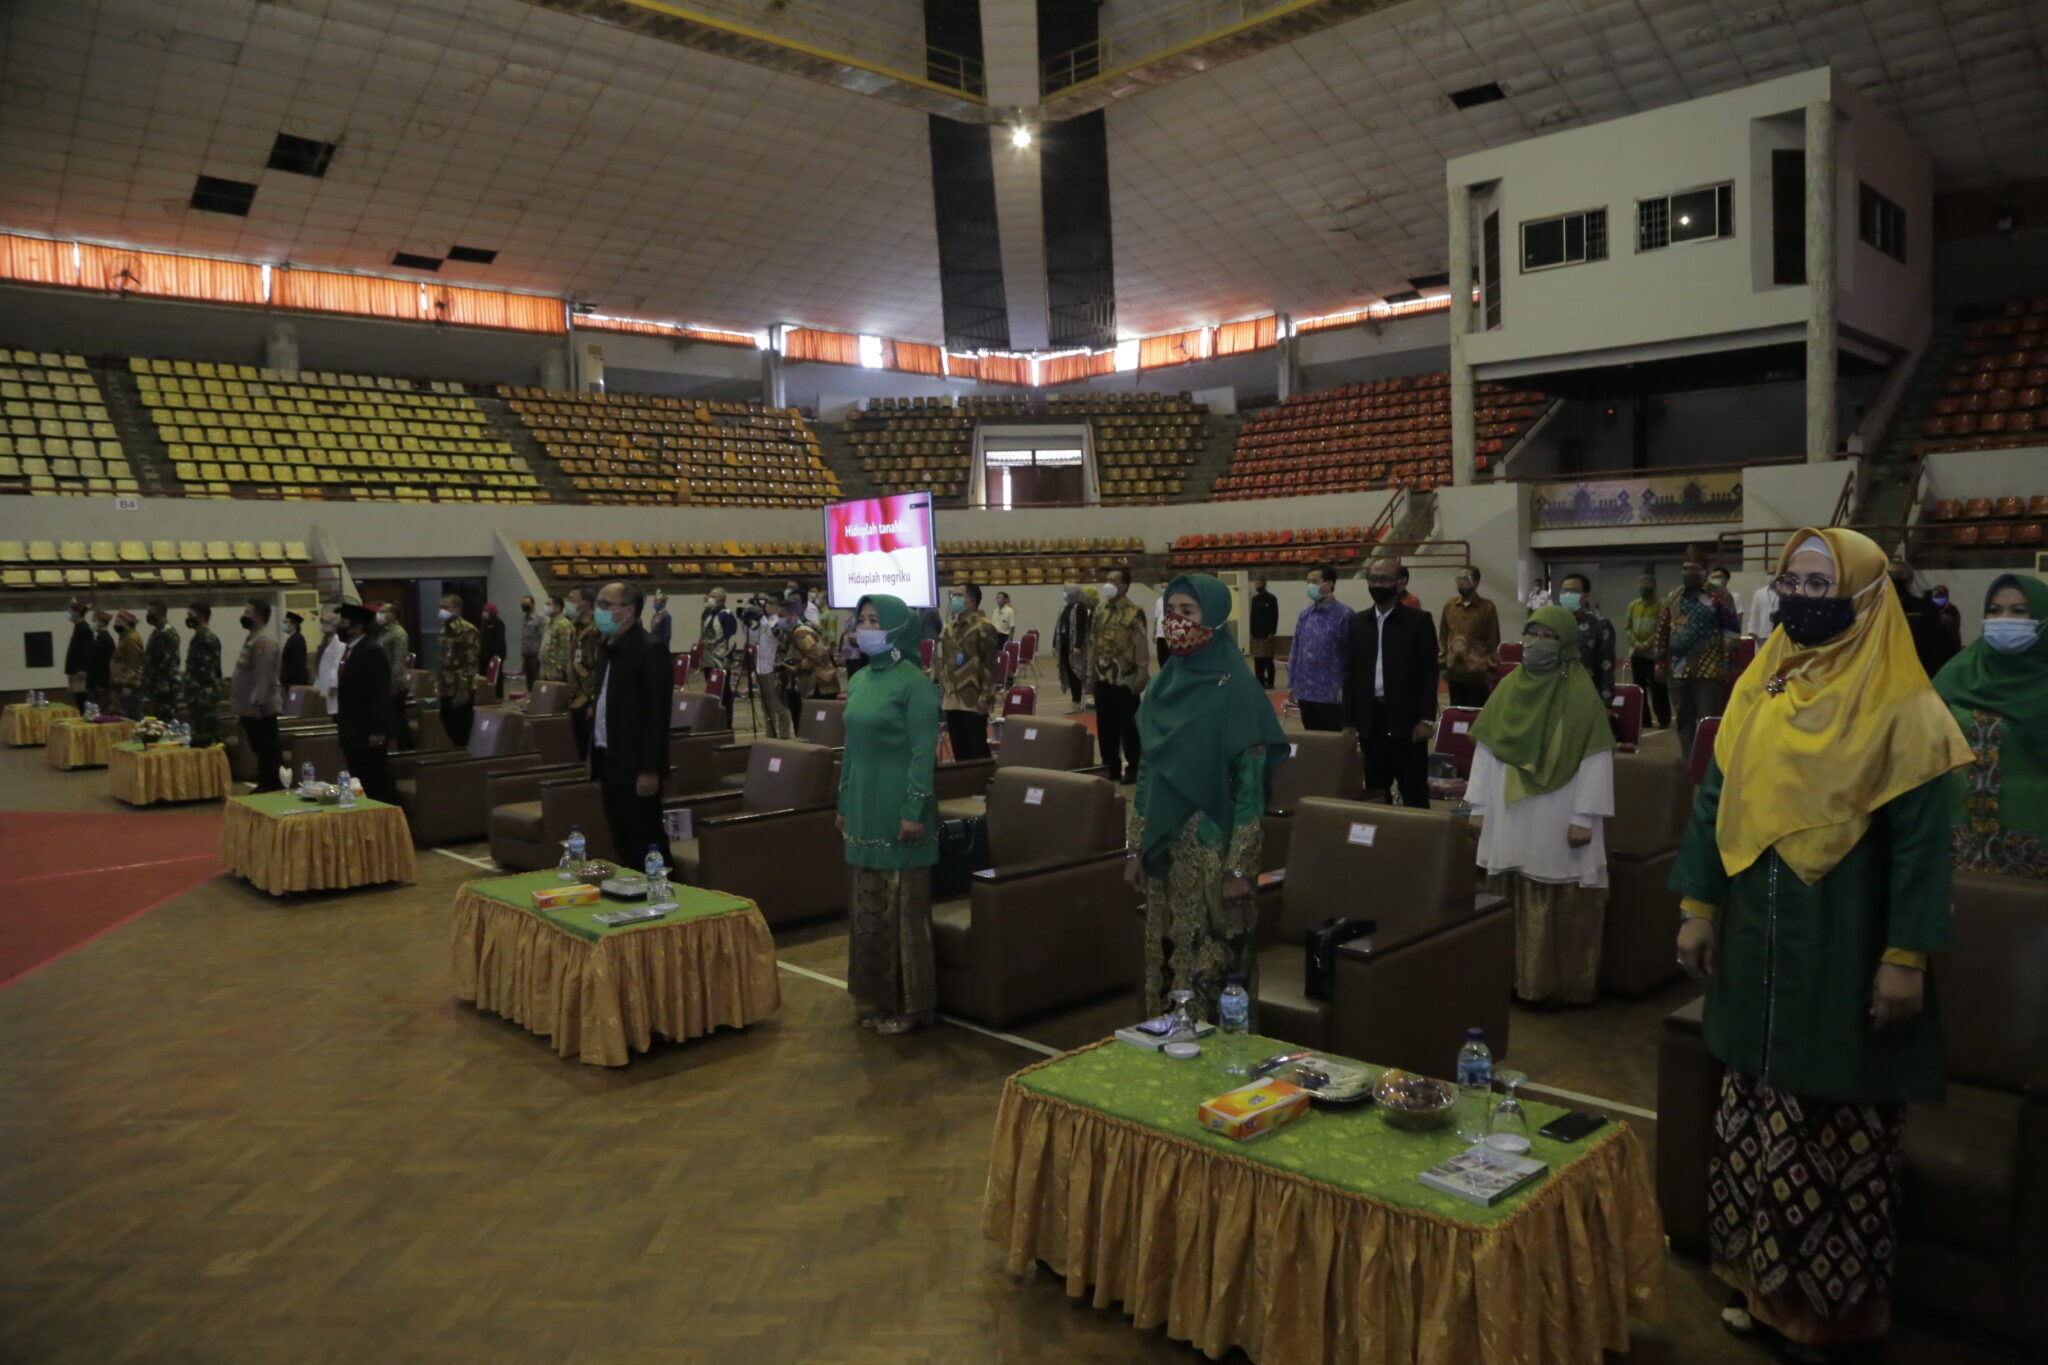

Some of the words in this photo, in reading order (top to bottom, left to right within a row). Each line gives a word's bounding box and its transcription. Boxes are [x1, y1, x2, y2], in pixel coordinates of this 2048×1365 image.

[845, 522, 877, 538] Hiduplah
[848, 571, 880, 586] Hiduplah
[882, 570, 911, 585] negriku
